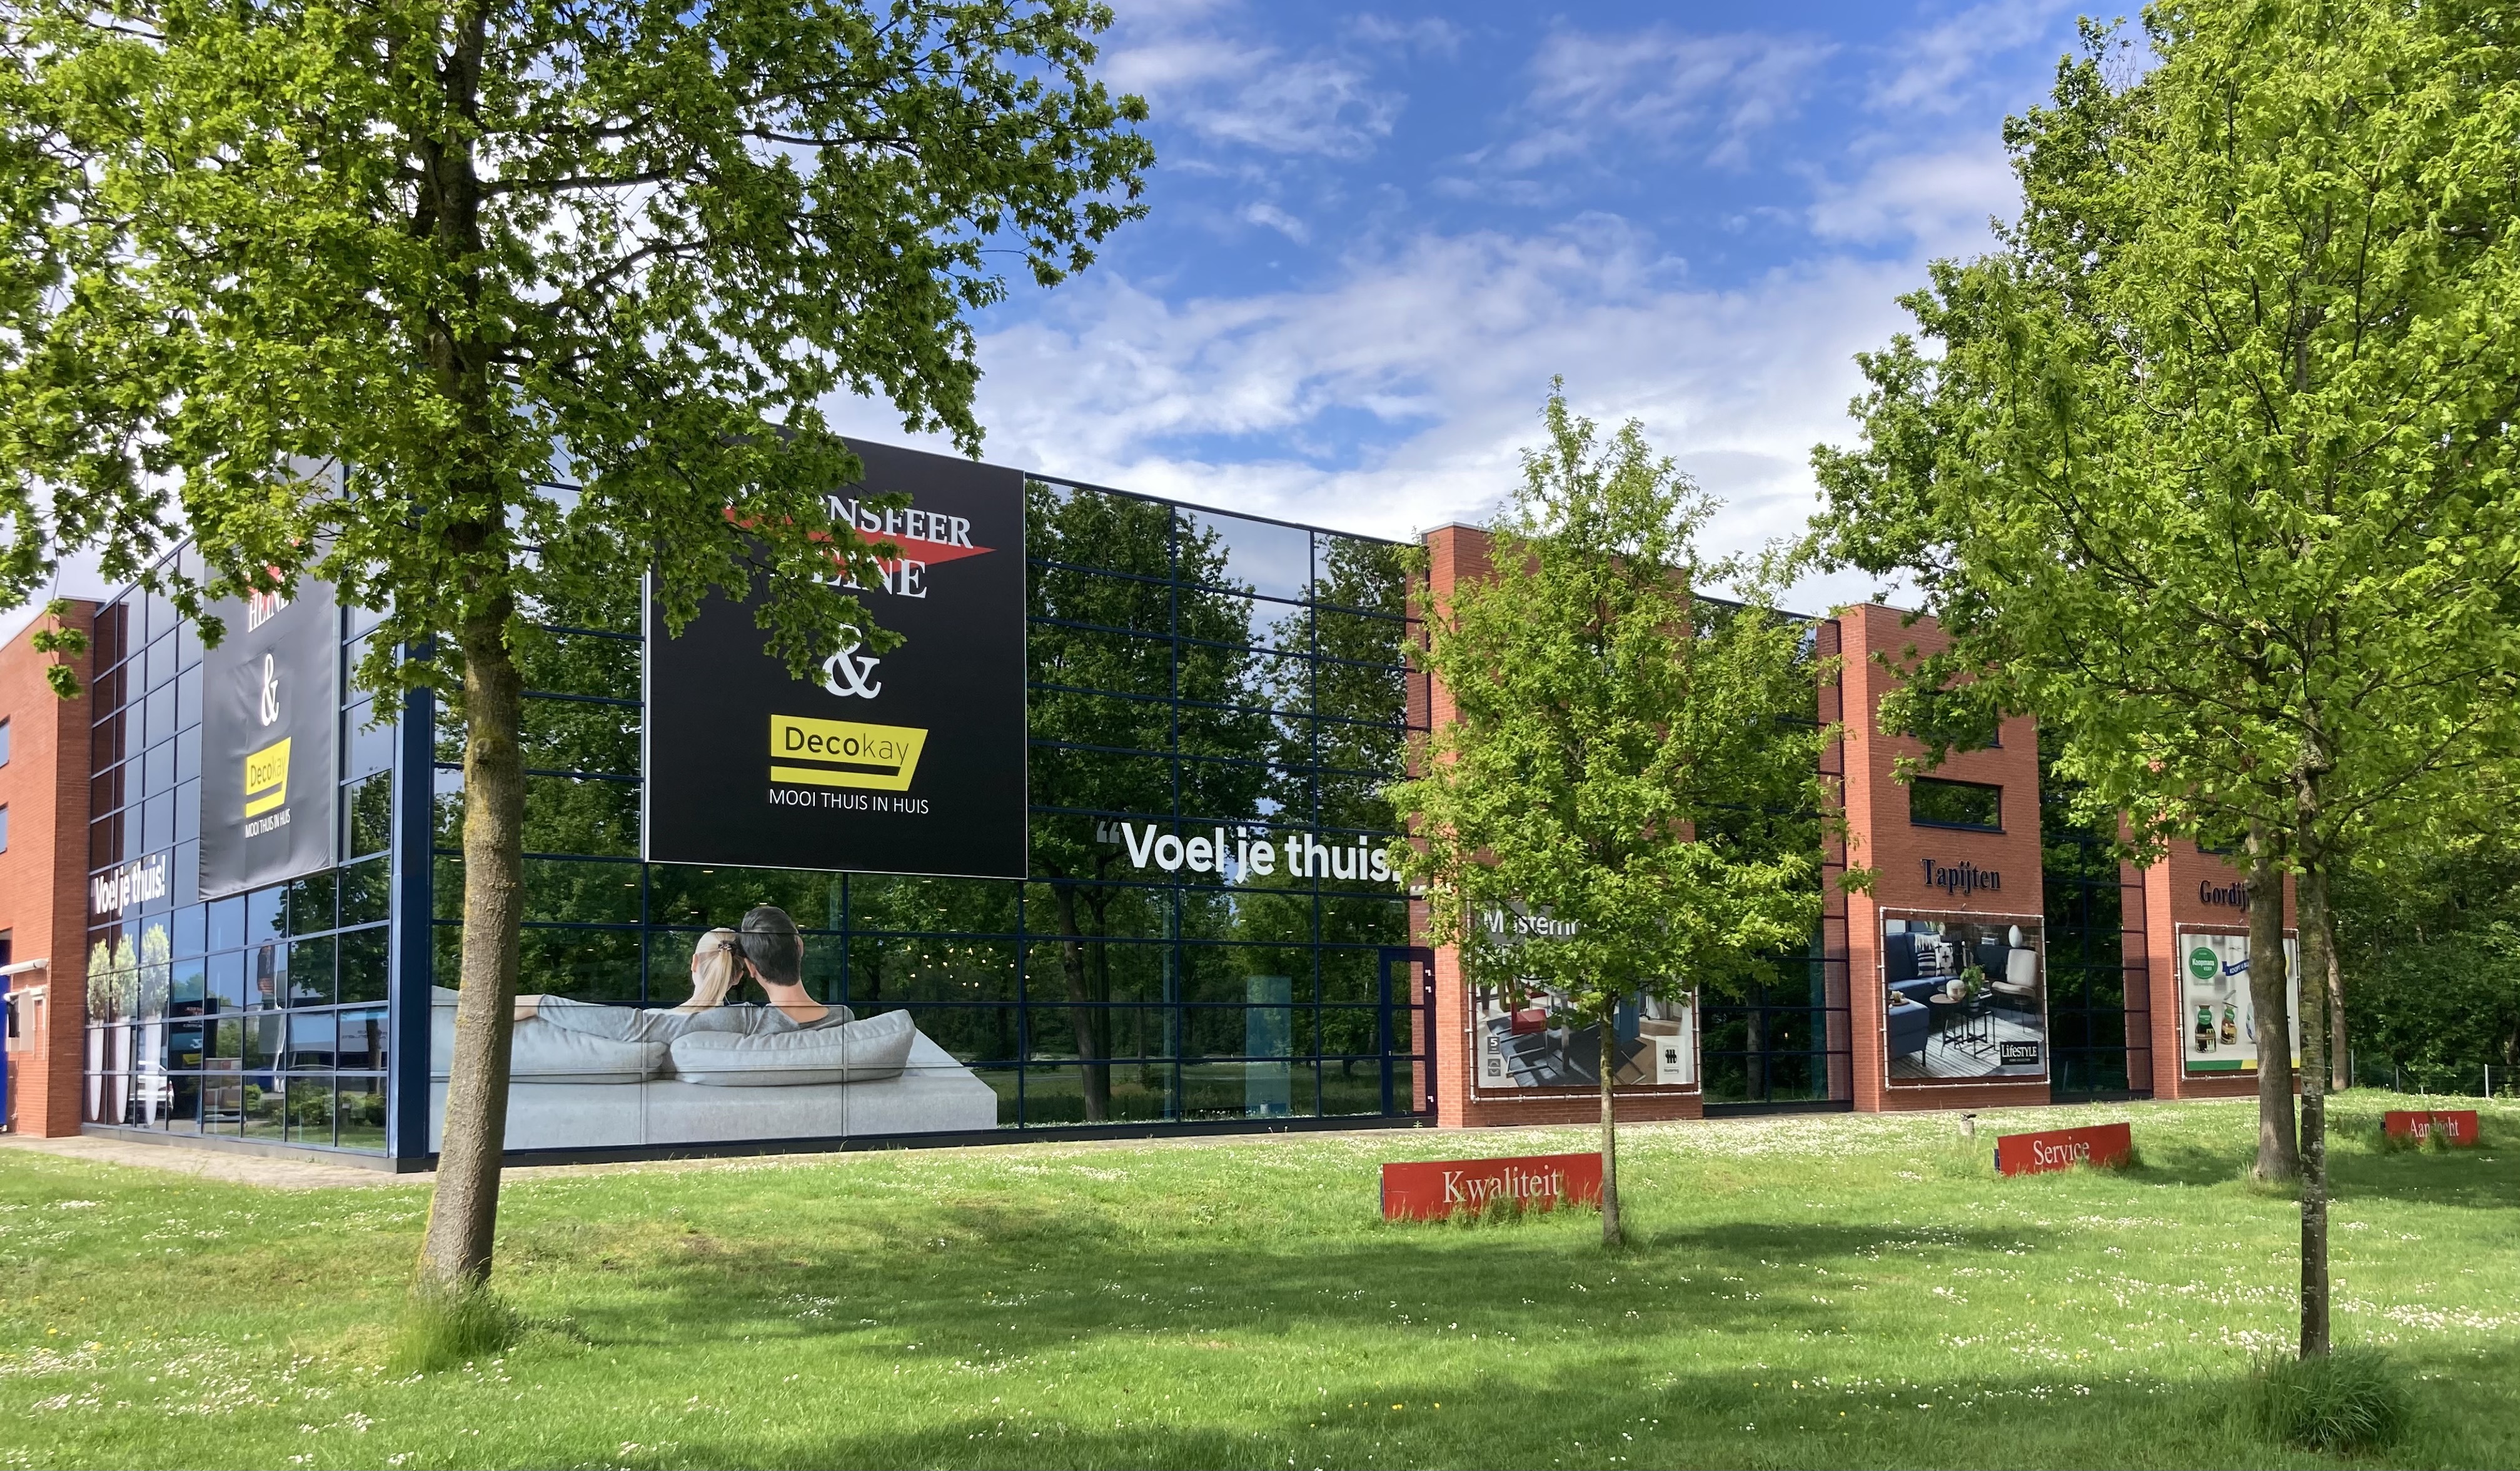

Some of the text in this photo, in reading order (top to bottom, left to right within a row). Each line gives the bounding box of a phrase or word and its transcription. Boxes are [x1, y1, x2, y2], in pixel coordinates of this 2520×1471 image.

[822, 623, 882, 699] &
[261, 653, 280, 726] &
[785, 726, 909, 766] Decokay
[250, 755, 286, 788] Decokay
[769, 788, 929, 815] MOOI THUIS IN HUIS
[245, 808, 291, 838] MOOI THUIS IN HUIS
[1234, 825, 1276, 885] je
[118, 865, 130, 917] je
[131, 855, 166, 903] thuis!
[1920, 858, 2001, 895] Tapijten
[1490, 1038, 1498, 1047] 5
[2034, 1135, 2090, 1166] Service
[1442, 1164, 1561, 1203] Kwaliteit
